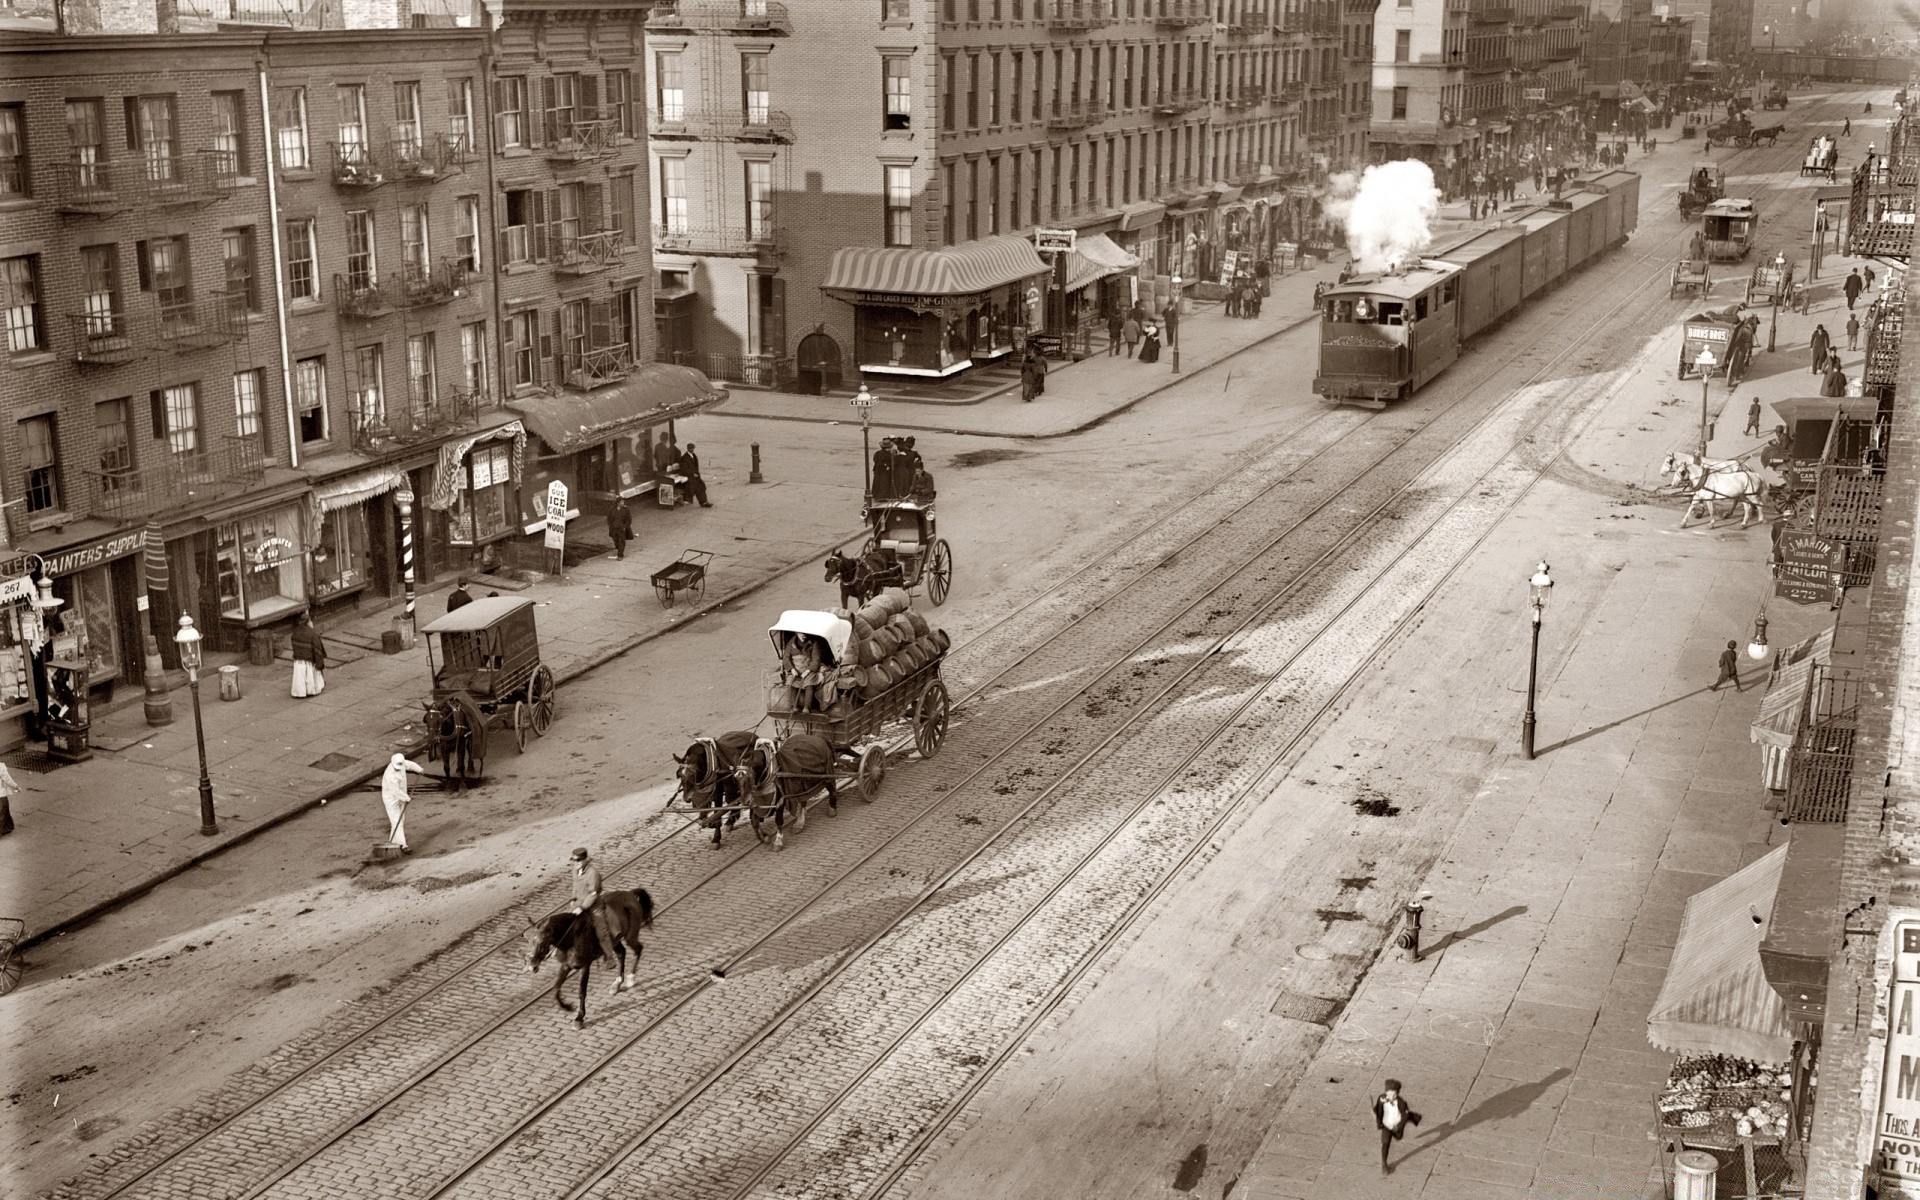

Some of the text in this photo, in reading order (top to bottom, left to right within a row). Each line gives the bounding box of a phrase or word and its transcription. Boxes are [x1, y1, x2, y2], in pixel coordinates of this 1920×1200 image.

[550, 496, 565, 507] ICE
[548, 506, 565, 517] COAL
[547, 522, 564, 533] WOOD
[43, 545, 103, 575] PAINTERS
[1786, 561, 1828, 579] TAILOR
[4, 581, 20, 594] 267
[1790, 588, 1817, 600] 272
